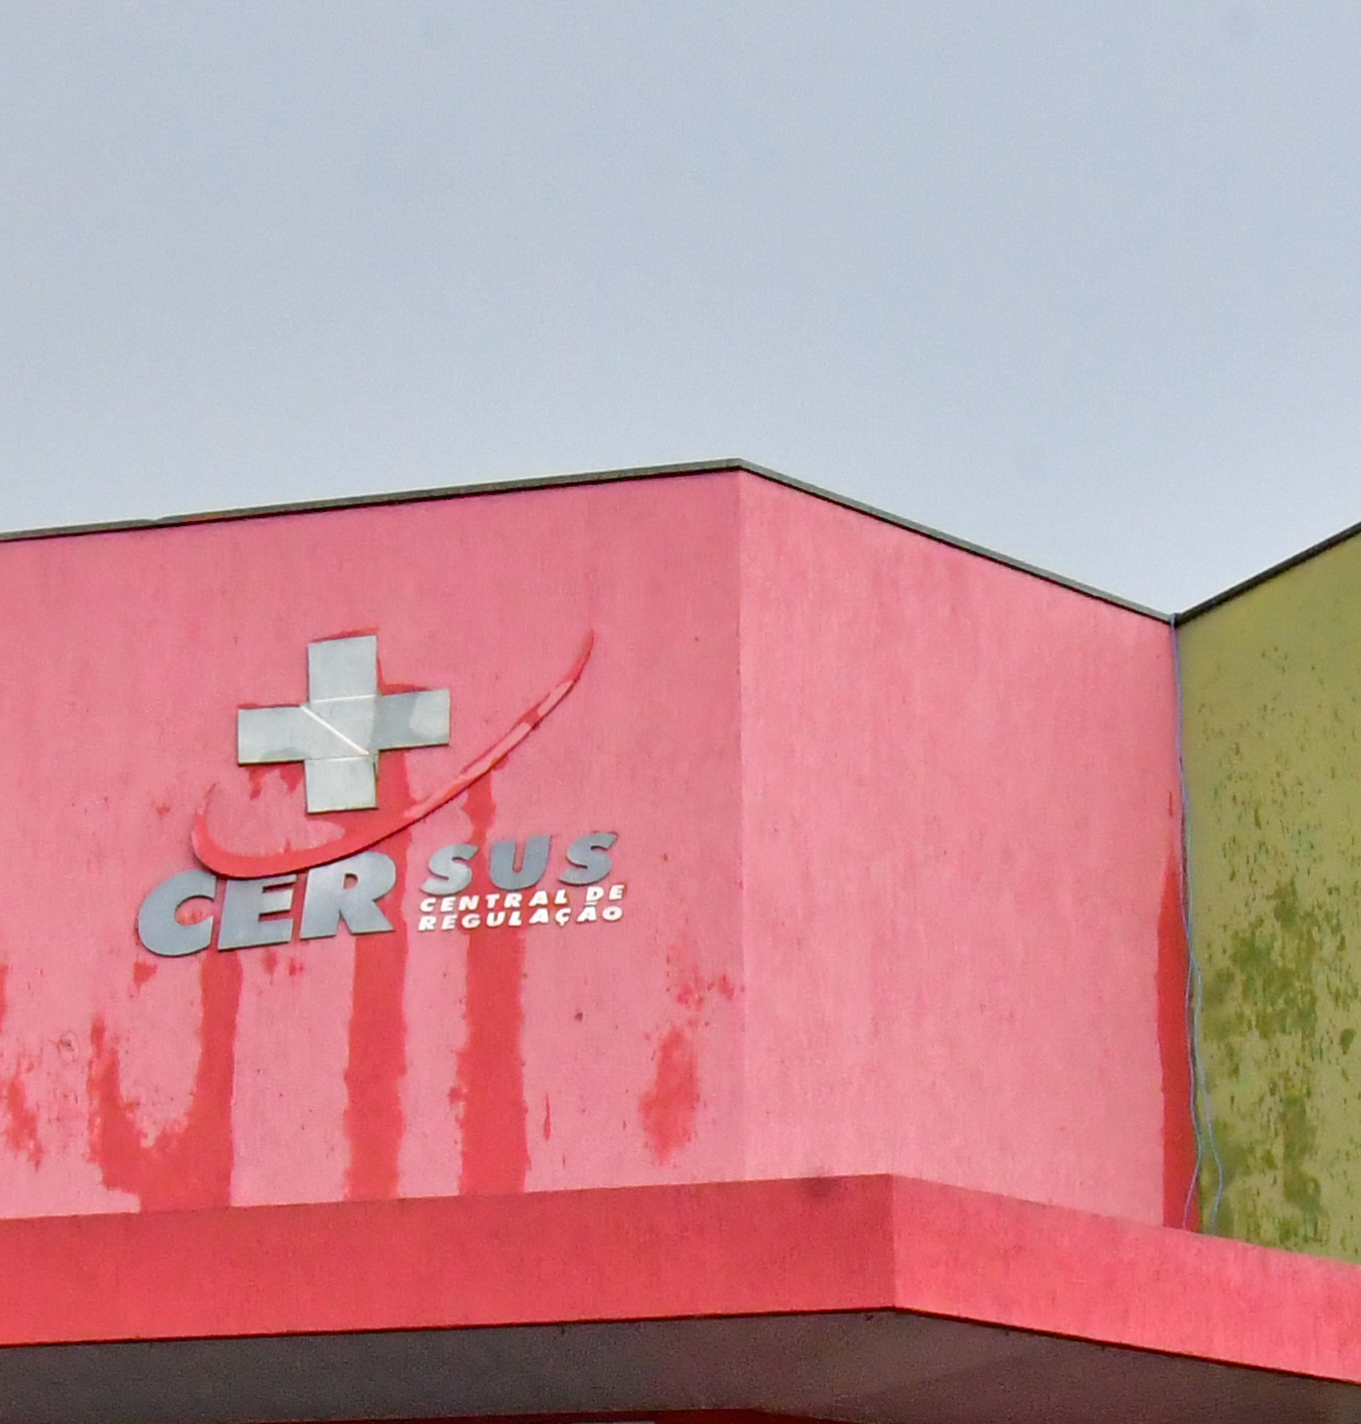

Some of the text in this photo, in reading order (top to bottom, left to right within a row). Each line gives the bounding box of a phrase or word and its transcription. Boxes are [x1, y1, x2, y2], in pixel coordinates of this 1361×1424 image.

[137, 832, 618, 957] CER SUS
[419, 884, 625, 912] CENTRAL DE
[417, 899, 623, 931] REGULAÇÃO
